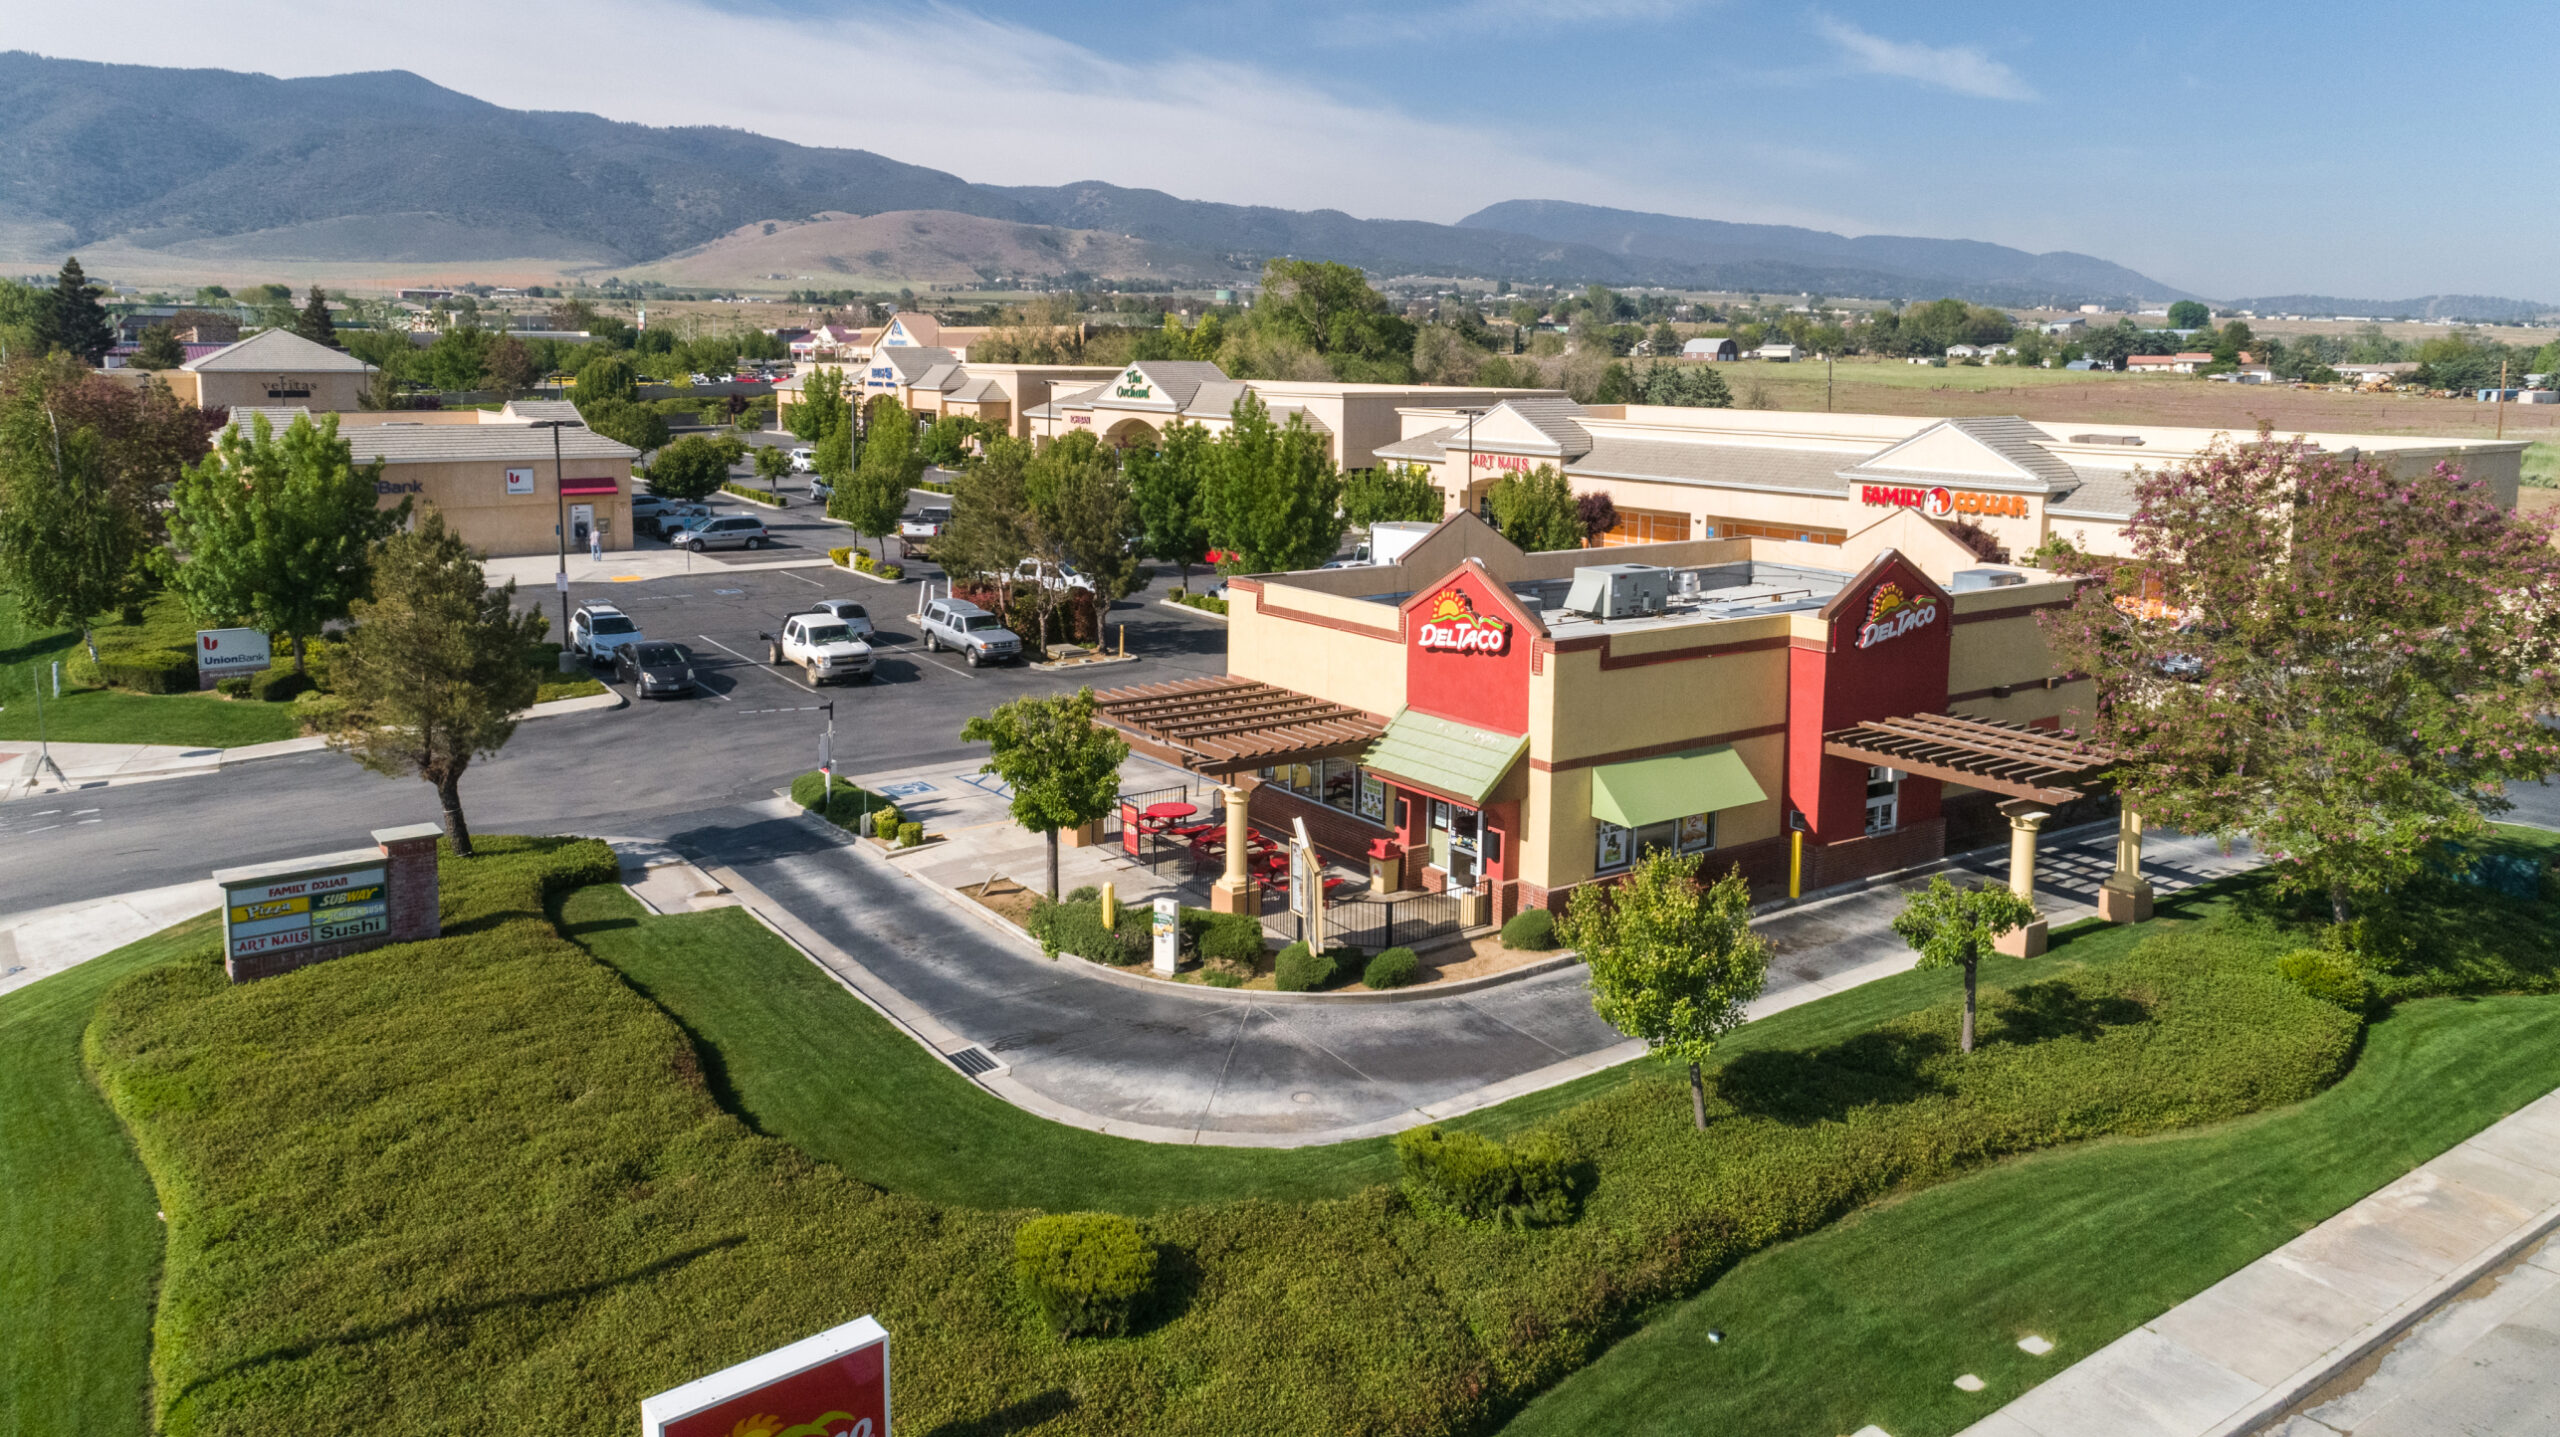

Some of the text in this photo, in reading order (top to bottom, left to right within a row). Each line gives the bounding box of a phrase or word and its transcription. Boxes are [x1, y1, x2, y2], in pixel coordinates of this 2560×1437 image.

[262, 379, 317, 390] veritas
[1127, 370, 1142, 384] The
[1116, 385, 1152, 399] Orchard
[1472, 454, 1529, 473] ART NAILS
[1862, 485, 2028, 517] FAMILY DOLLAR
[204, 653, 265, 665] UnionBank
[269, 877, 348, 897] FAMILY DOLLAR
[319, 888, 378, 907] SUBWAY
[246, 902, 292, 919] Pizza
[320, 918, 380, 939] Sushi
[235, 930, 309, 951] ART NAILS
